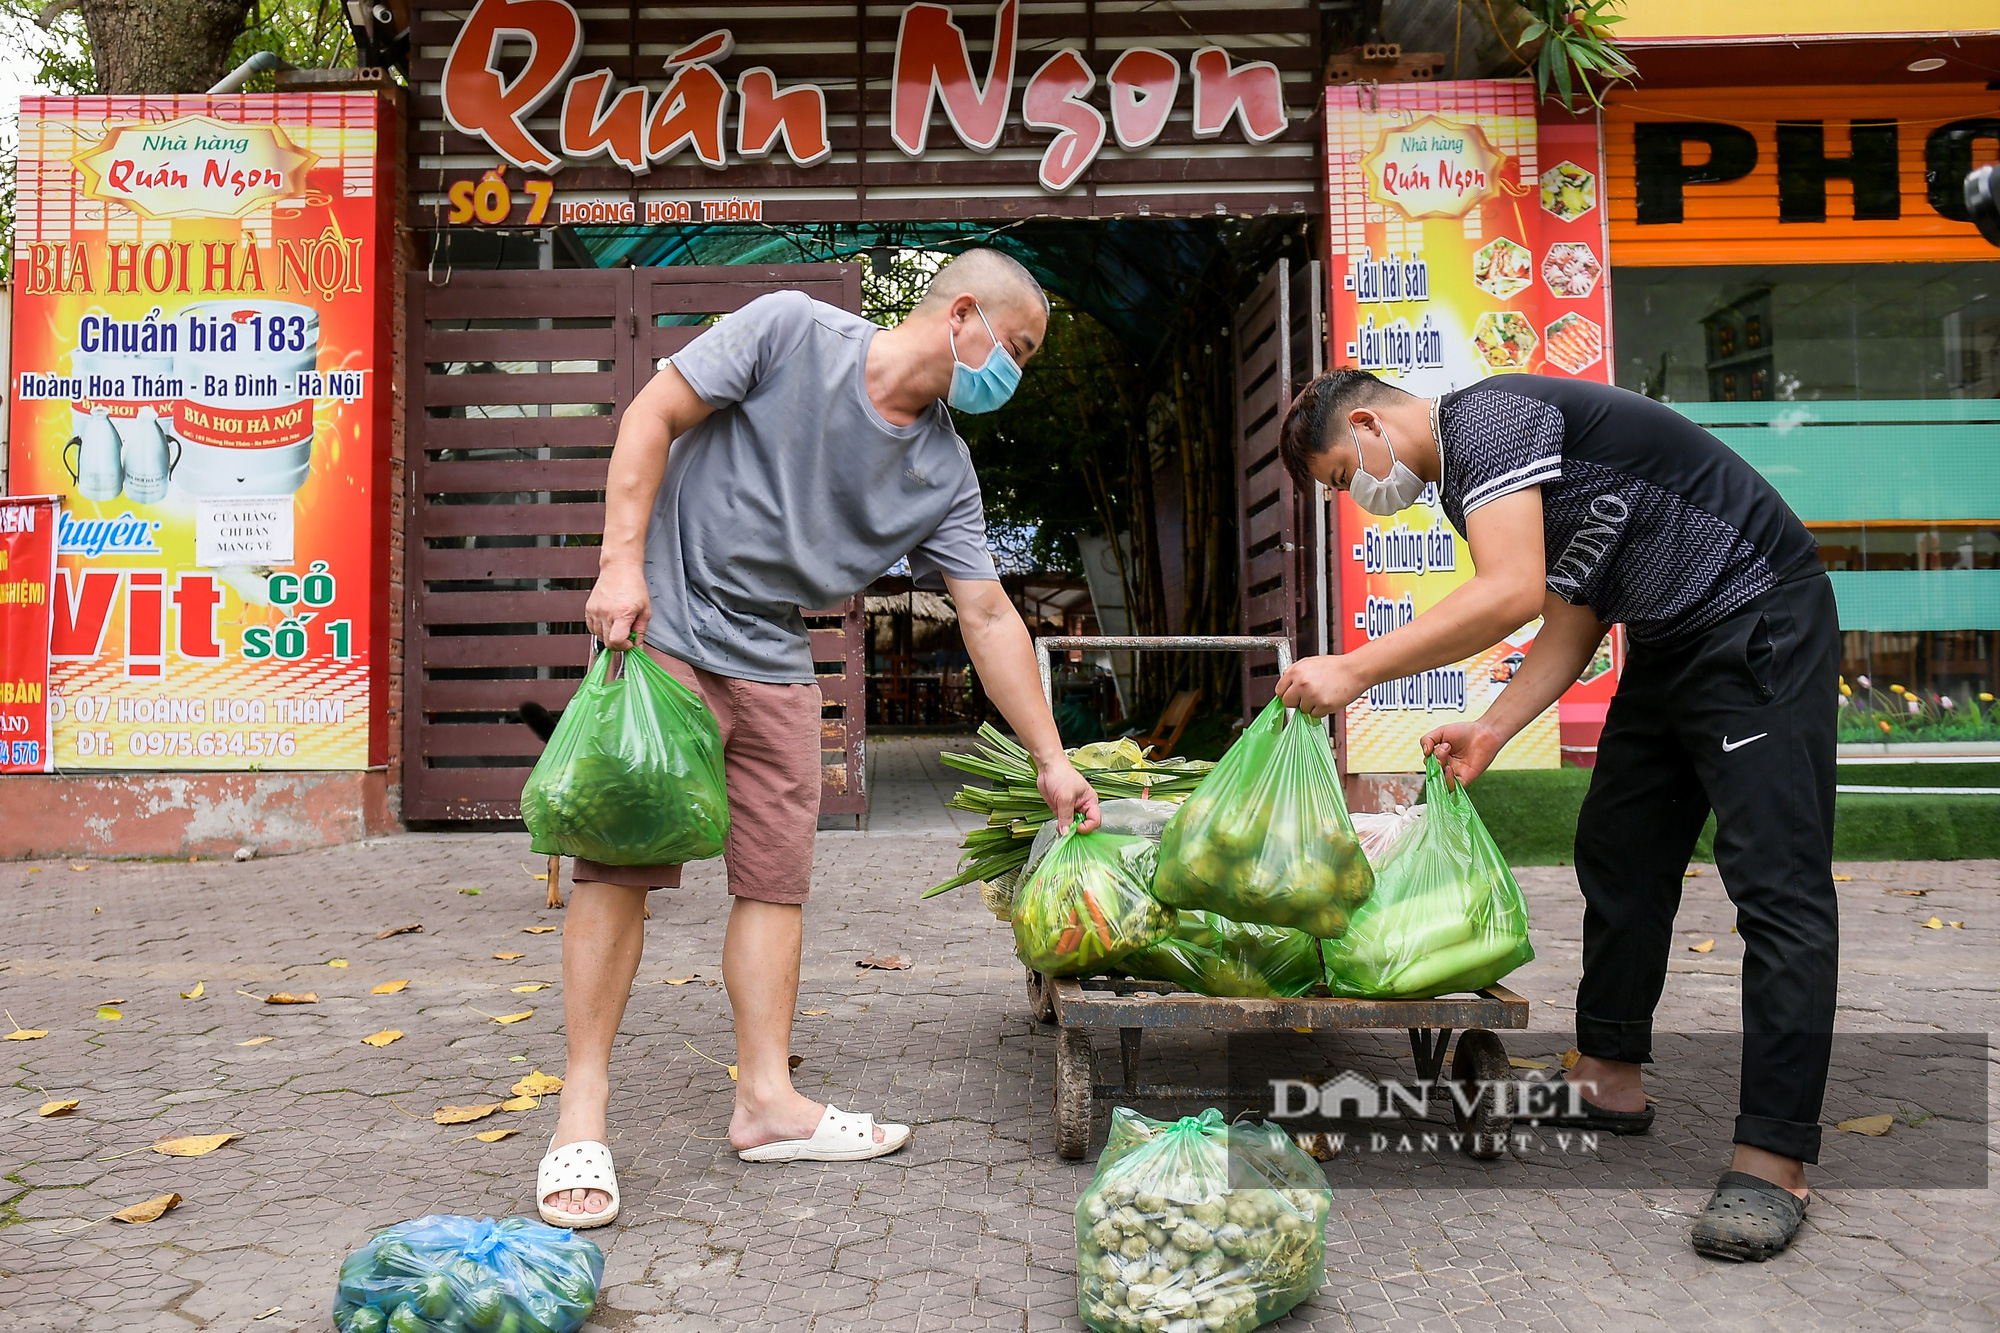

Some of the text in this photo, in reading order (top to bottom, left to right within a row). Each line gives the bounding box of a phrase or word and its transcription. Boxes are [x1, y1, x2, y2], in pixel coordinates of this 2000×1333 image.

[441, 0, 1288, 193] Quán Ngon
[142, 135, 249, 154] Nhà hàng
[1401, 135, 1463, 154] Nhà hàng
[108, 159, 282, 196] Quán Ngon
[1383, 159, 1485, 197] Quán Ngon
[448, 164, 762, 225] SỐ 7 HOÀNG HOA THÁM
[25, 226, 363, 302] BIA HƠI HÀ NỘI
[1357, 250, 1427, 298] Lẩu hải sản
[80, 308, 305, 353] Chuẩn bia 183
[1359, 316, 1380, 365] Lẩu
[1415, 314, 1441, 363] cẩm
[22, 373, 82, 401] Hoàng
[88, 376, 125, 397] Hoa
[132, 374, 183, 397] Thám
[204, 376, 231, 397] Ba
[234, 373, 277, 397] Đình
[299, 373, 325, 397] Hà
[329, 373, 362, 402] Nội
[184, 406, 210, 429] BIA
[212, 416, 243, 433] HƠI
[247, 415, 270, 433] HÀ
[273, 408, 303, 430] NỘI
[213, 510, 277, 522] CỬA HÀNG
[246, 524, 269, 536] BÁN
[217, 542, 254, 552] MANG
[1366, 518, 1454, 571] Bò nhúng dấm
[325, 621, 351, 660] 1
[118, 694, 206, 723] HOÀNG
[213, 698, 265, 723] HOA
[274, 694, 344, 723] THÁM
[12, 740, 39, 765] 576
[76, 731, 114, 756] ĐT:
